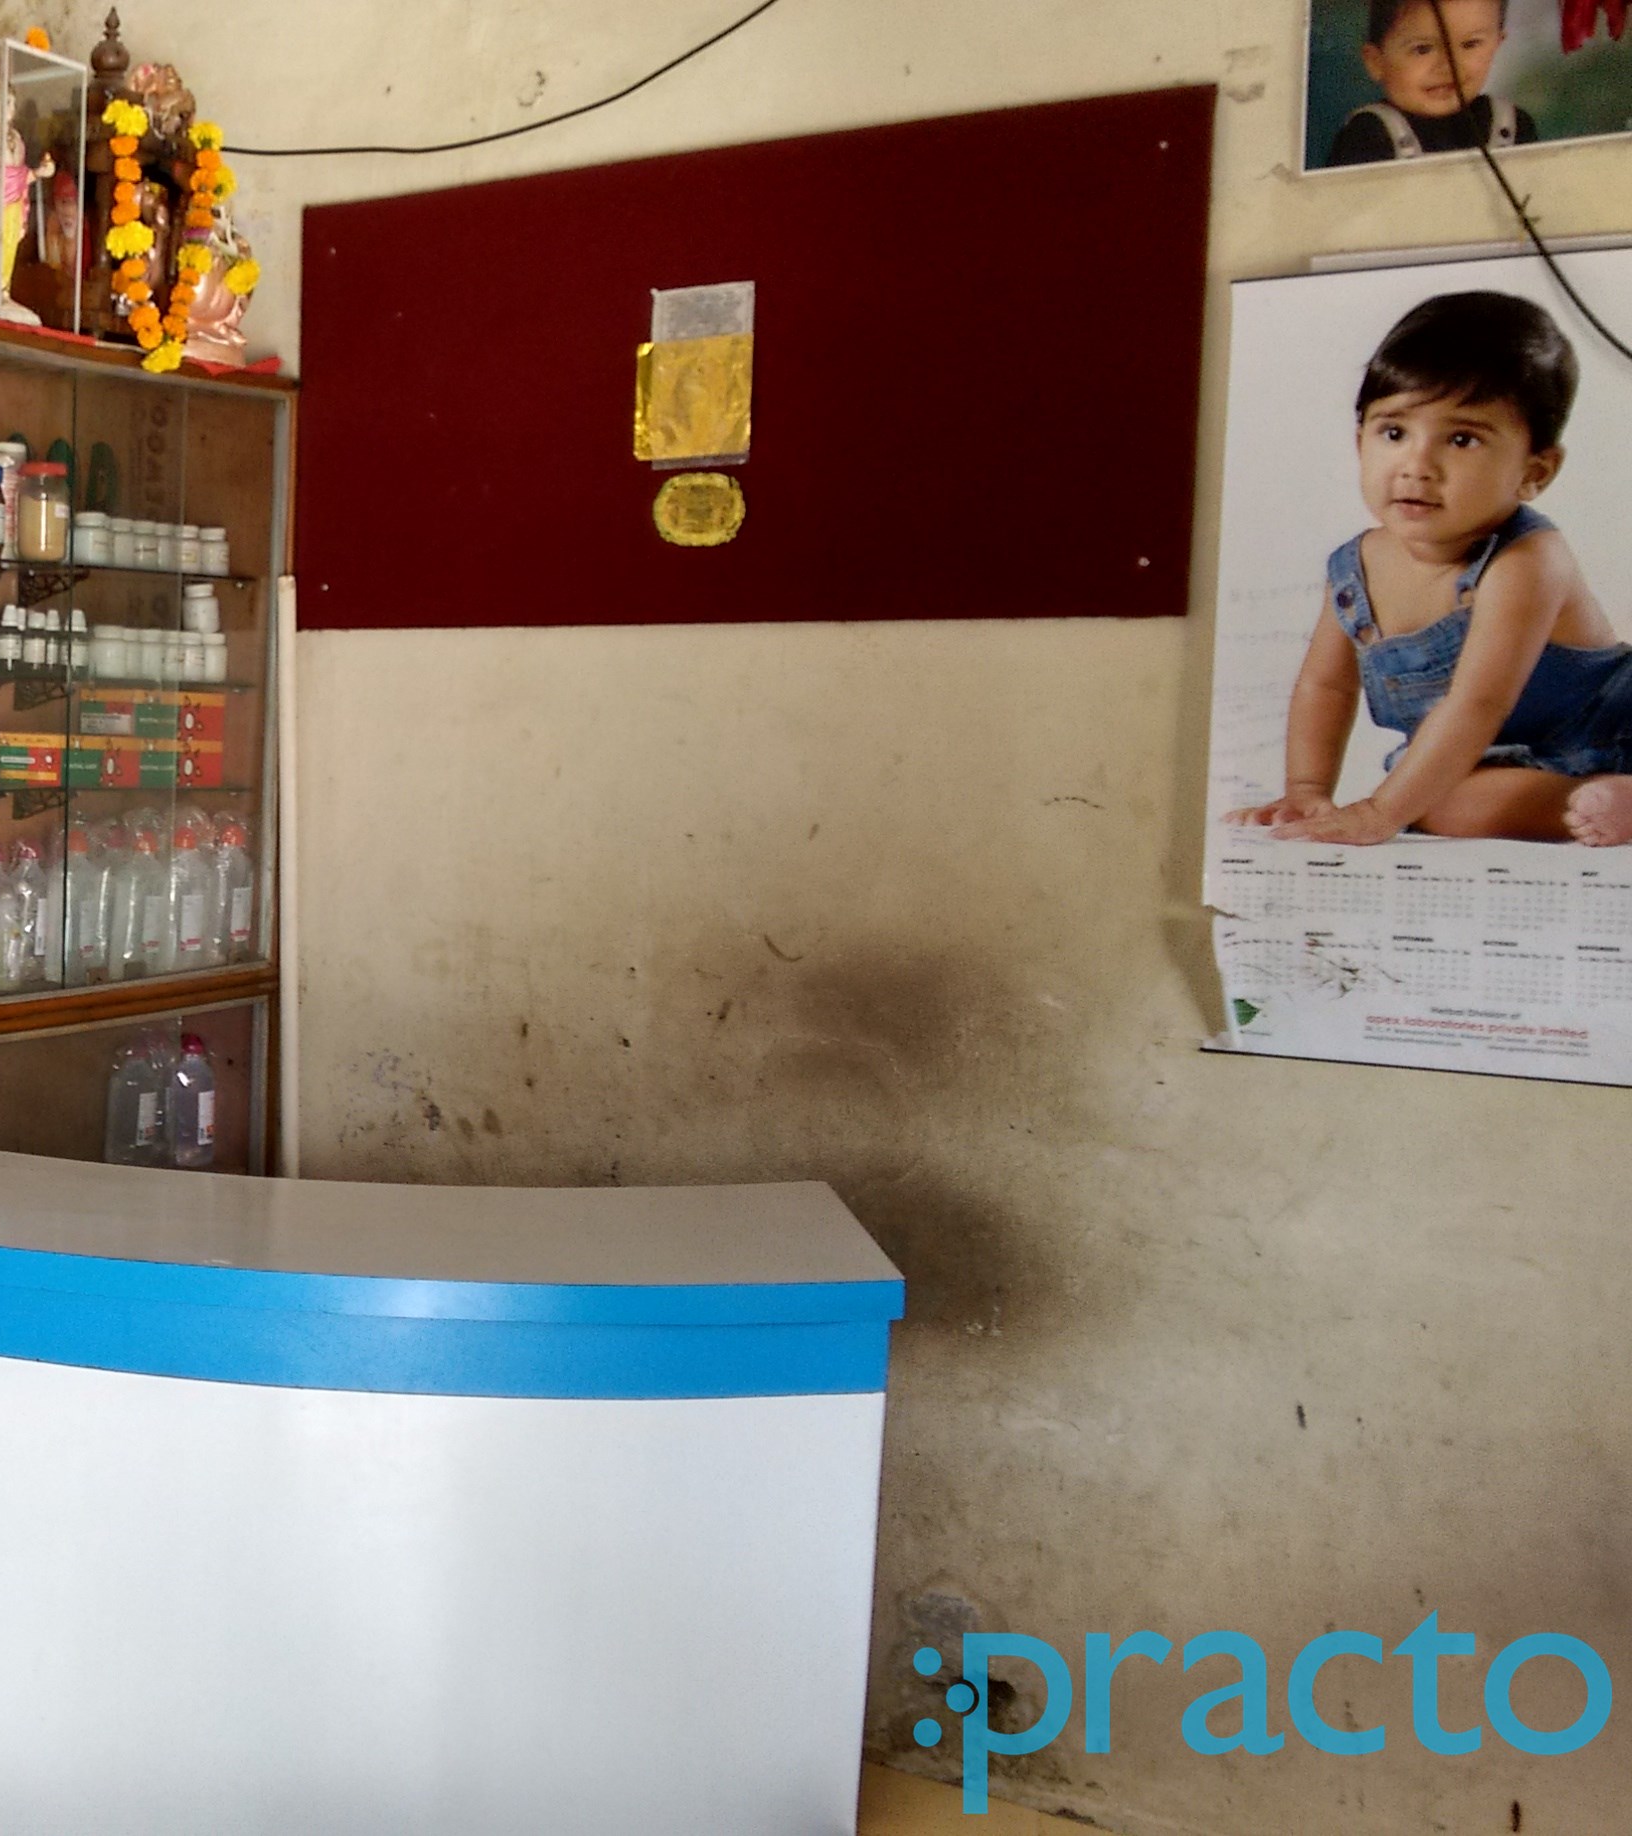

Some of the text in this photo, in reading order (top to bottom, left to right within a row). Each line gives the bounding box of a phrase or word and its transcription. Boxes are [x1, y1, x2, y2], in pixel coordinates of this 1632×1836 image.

[1366, 1015, 1399, 1027] apex
[1404, 1016, 1484, 1033] laboratories
[1488, 1023, 1536, 1037] private
[1540, 1026, 1589, 1040] limited
